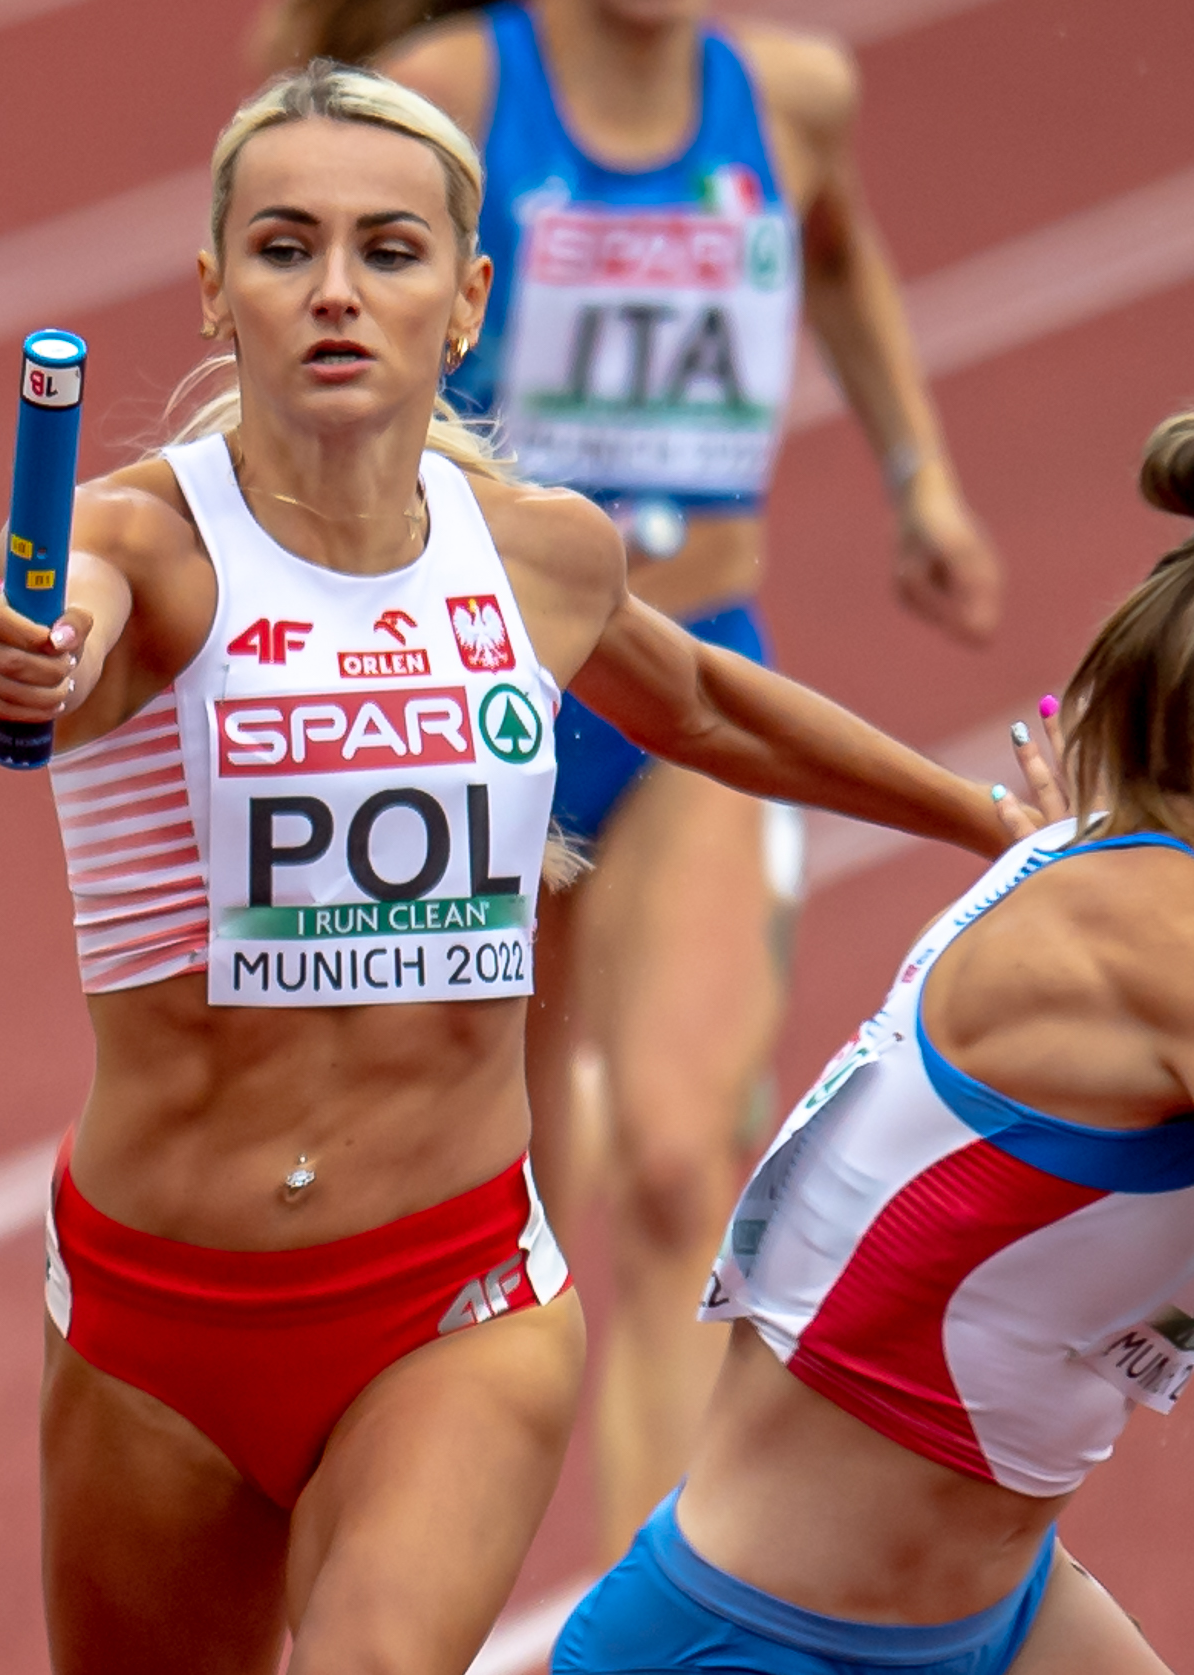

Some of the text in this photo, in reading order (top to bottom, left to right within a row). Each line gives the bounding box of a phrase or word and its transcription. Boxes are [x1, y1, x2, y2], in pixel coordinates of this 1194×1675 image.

[564, 304, 751, 408] ITA
[226, 618, 314, 664] 4F
[343, 652, 426, 675] ORLEN
[224, 697, 468, 767] SPAR
[248, 783, 522, 908] POL
[297, 910, 306, 936] I
[315, 906, 379, 936] RUN
[233, 940, 525, 992] MUNICH 2022
[436, 1250, 523, 1335] 4F
